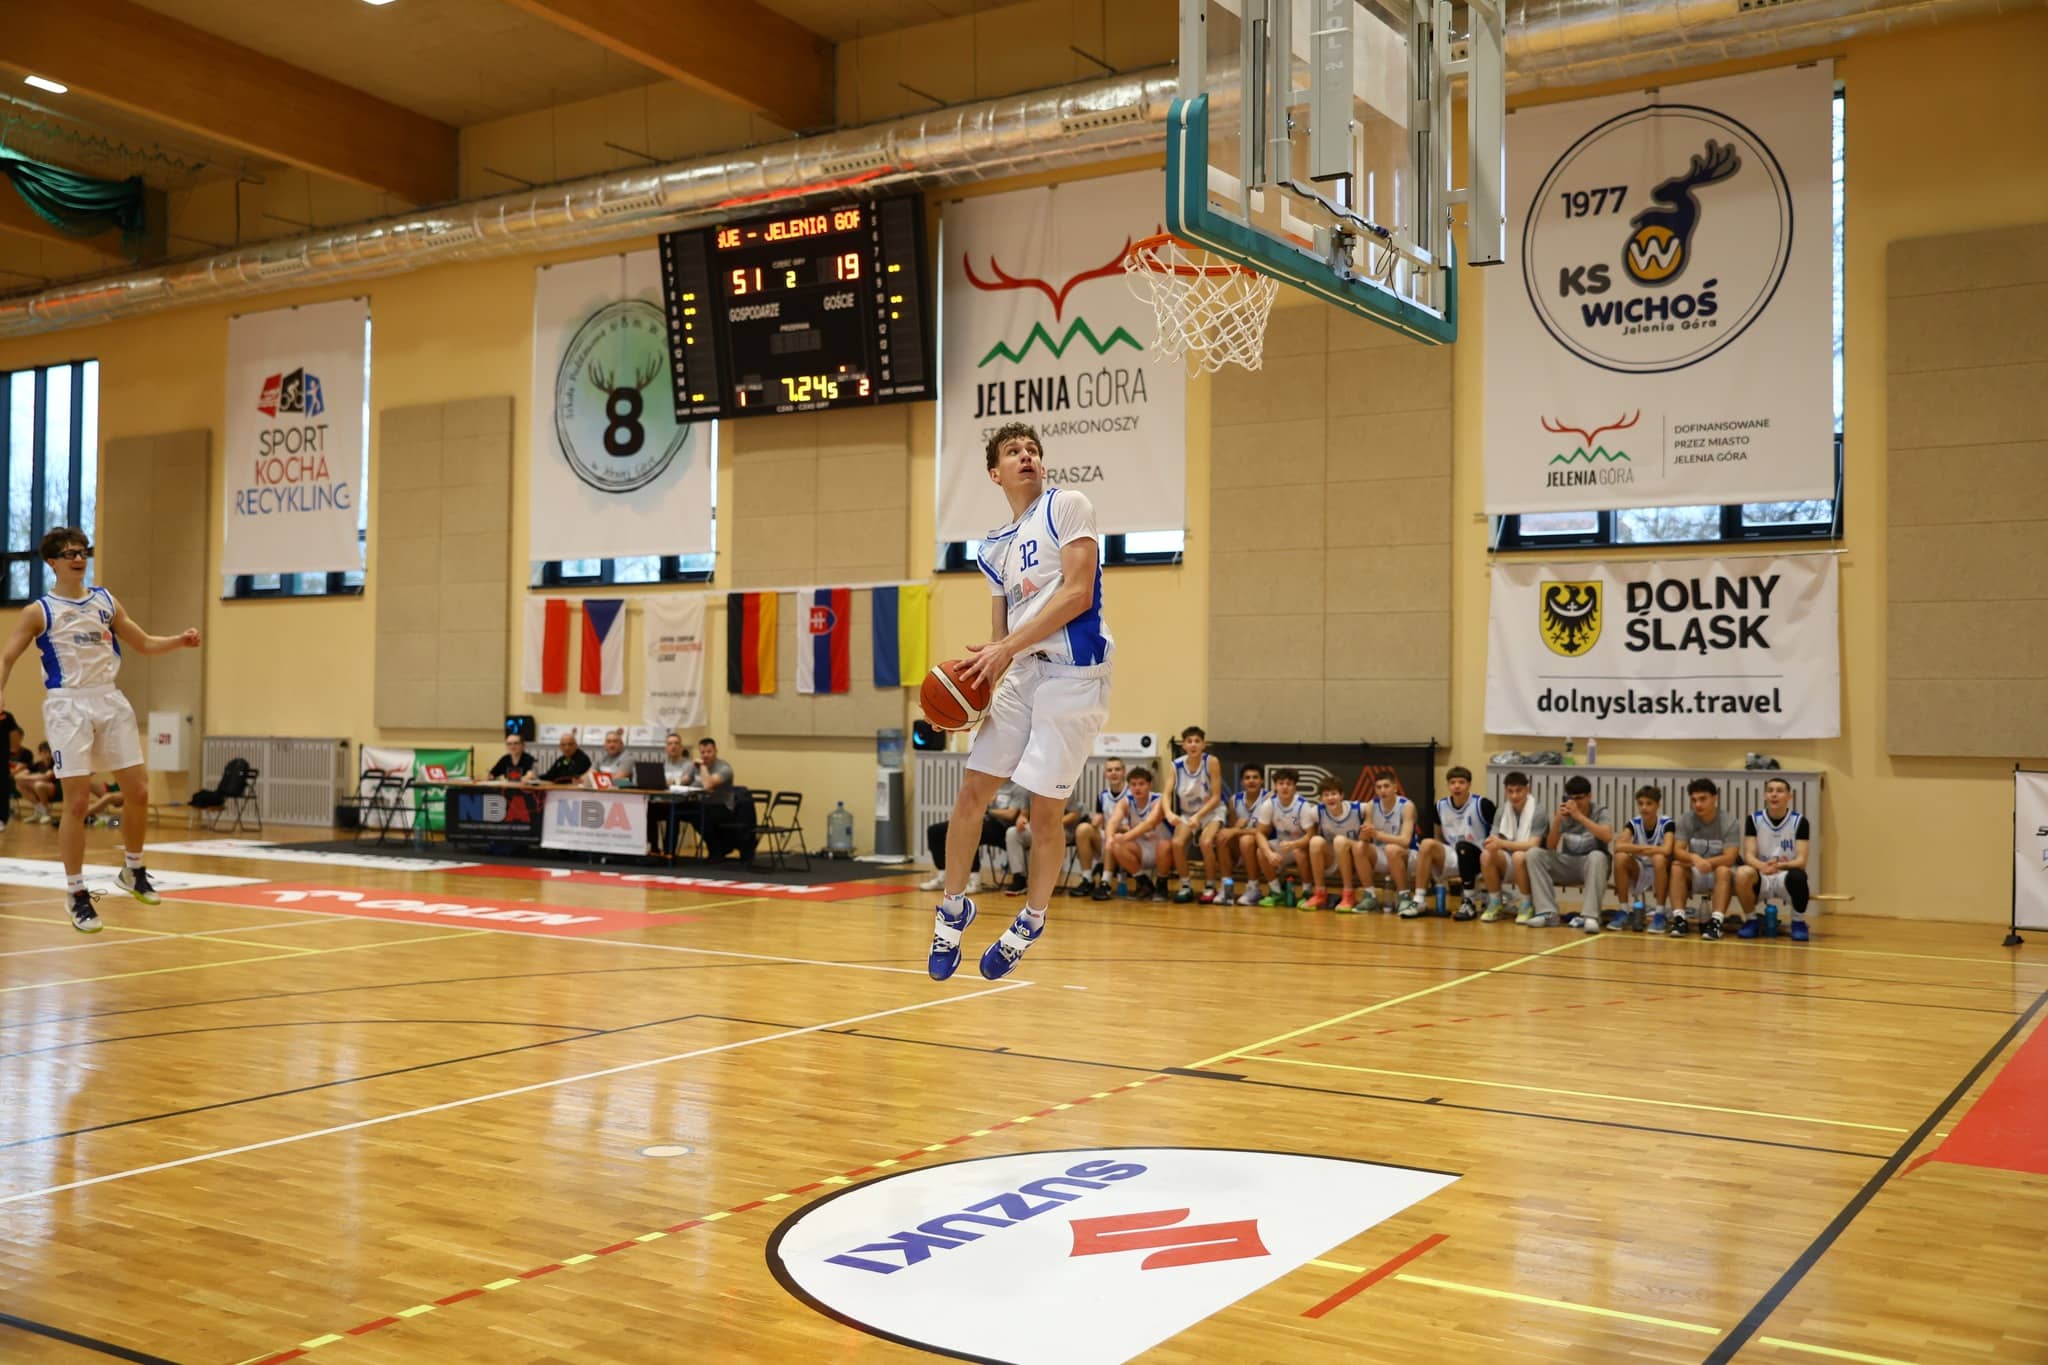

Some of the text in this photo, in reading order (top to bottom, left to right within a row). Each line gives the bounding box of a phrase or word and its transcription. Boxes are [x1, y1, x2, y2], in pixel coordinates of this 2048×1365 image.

[1561, 186, 1628, 218] 1977
[764, 215, 828, 242] JELENIA
[732, 267, 762, 295] 51
[785, 270, 797, 289] 2
[837, 253, 860, 280] 19
[1559, 264, 1612, 297] KS
[729, 302, 780, 322] GOSPODARZE
[823, 291, 855, 311] GOŚCIE
[1582, 278, 1718, 328] WICHOŚ
[1622, 317, 1718, 336] Jelenia Góra
[859, 378, 870, 396] 2
[974, 366, 1148, 418] JELENIA GÓRA
[604, 387, 645, 457] 8
[1041, 416, 1140, 438] KARKONOSZY
[1674, 419, 1770, 434] DOFINANSOWANE
[259, 424, 329, 456] SPORT
[1674, 435, 1750, 449] PRZEZ MIASTO
[255, 456, 330, 486] KOCHA
[1673, 450, 1747, 464] JELENIA GÓRA
[1046, 465, 1104, 485] RASZA
[1546, 467, 1634, 487] JELENIA GÓRA
[235, 482, 351, 515] RECYKLING
[1019, 539, 1039, 572] 32
[1626, 575, 1780, 613] DOLNY
[1624, 608, 1770, 655] ŚLĄSK
[1537, 687, 1783, 720] dolnyslask.travel
[458, 793, 531, 823] NBA
[556, 799, 632, 832] NBA
[823, 1159, 1148, 1275] SUZUKI
